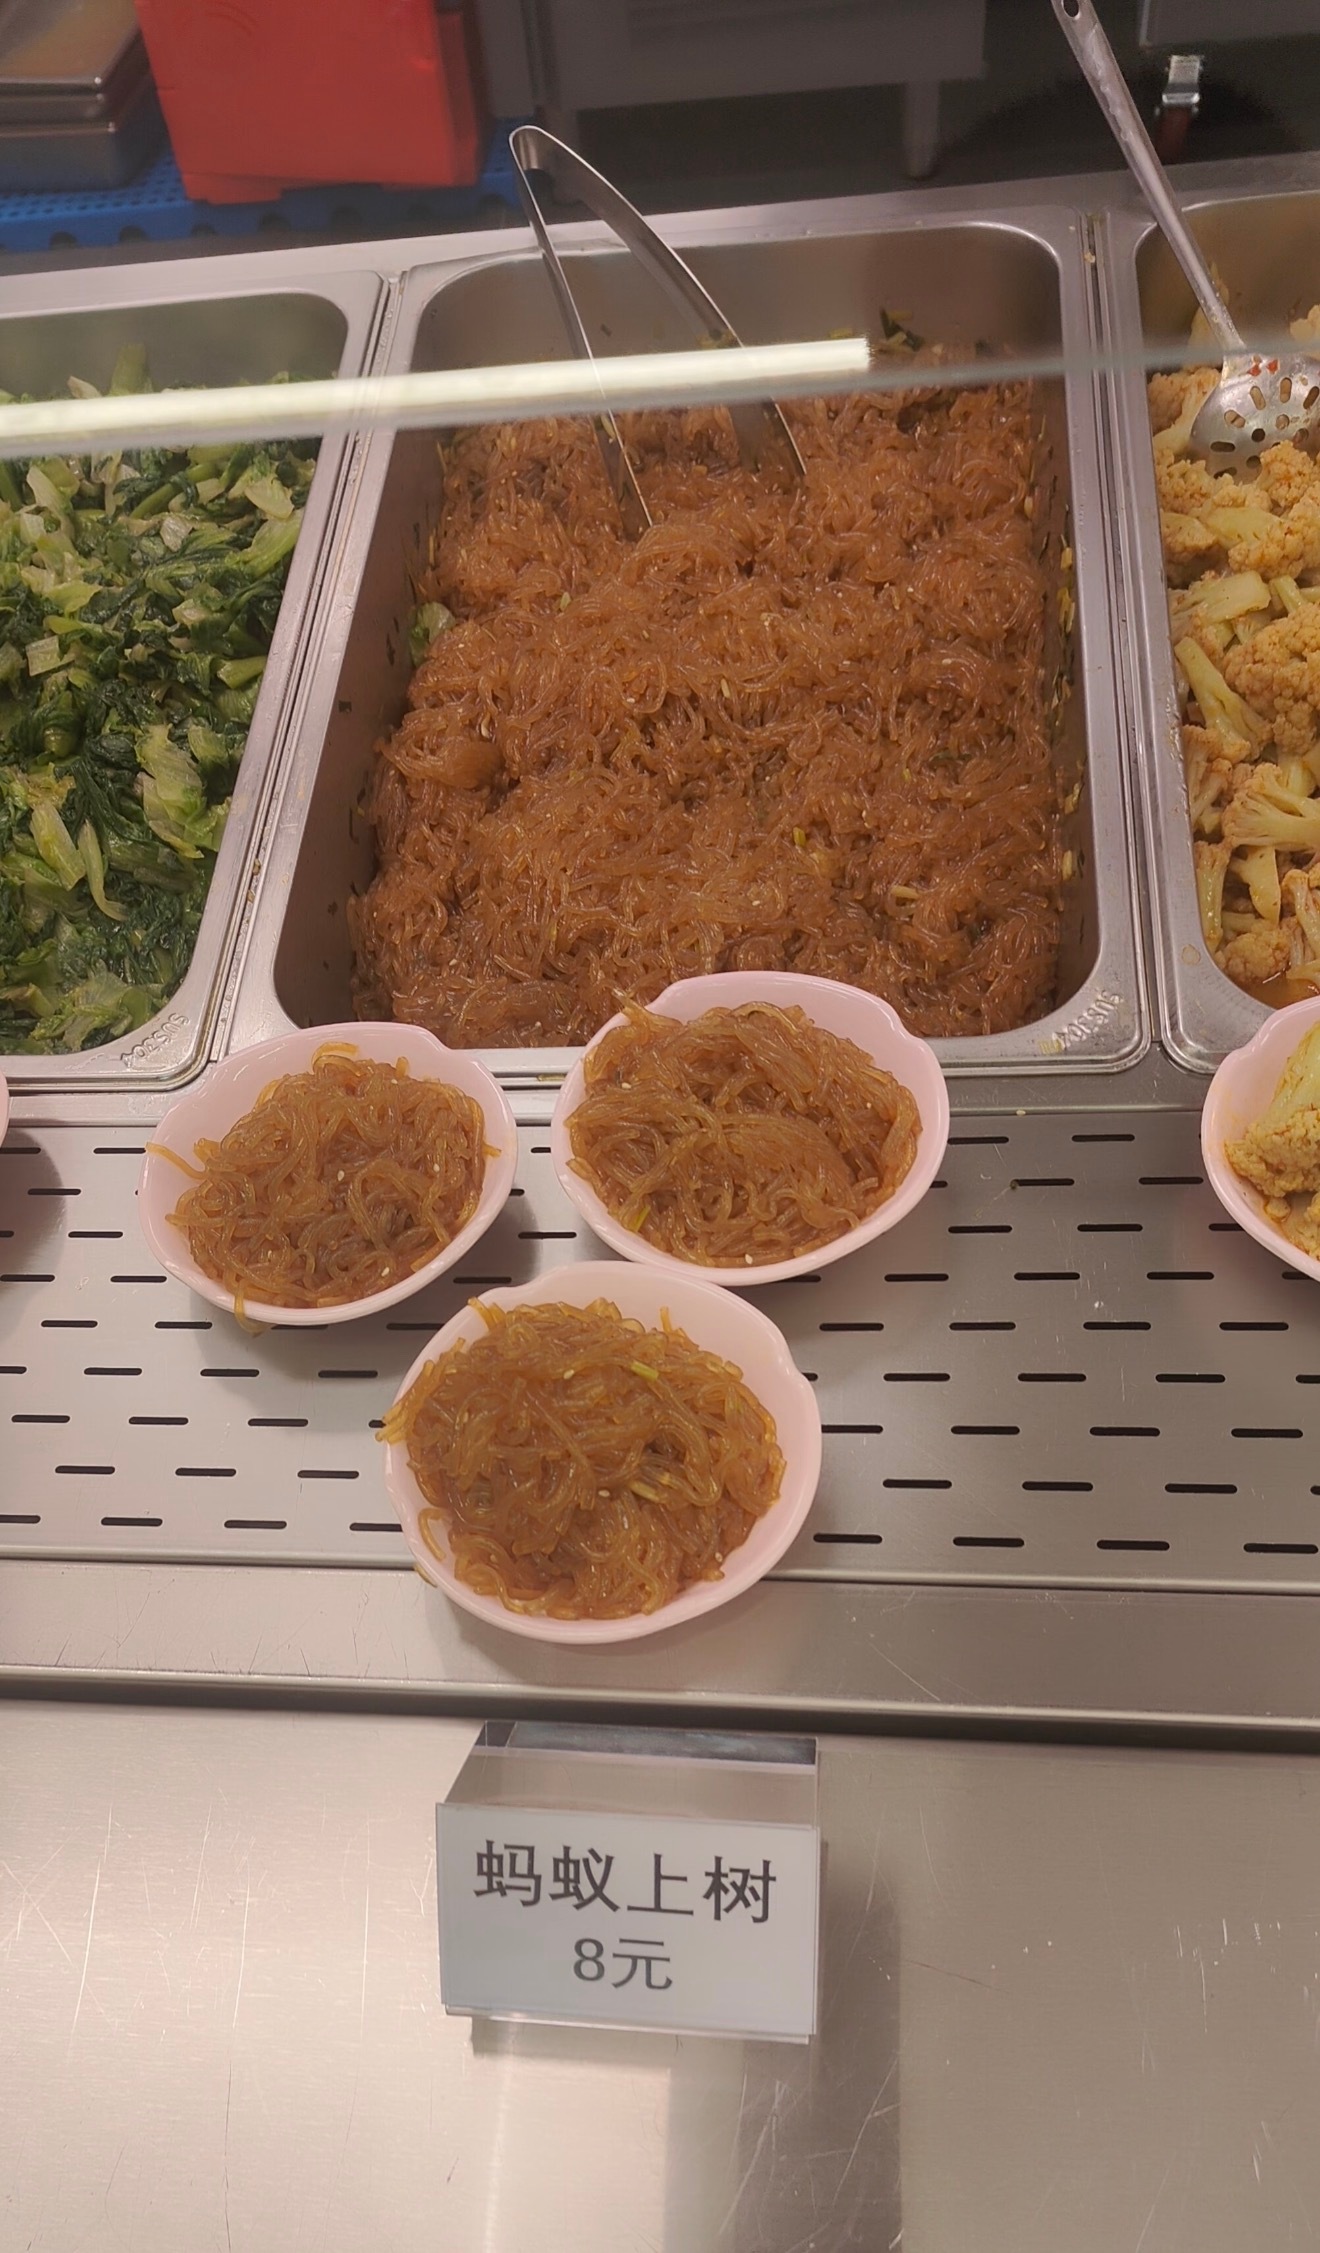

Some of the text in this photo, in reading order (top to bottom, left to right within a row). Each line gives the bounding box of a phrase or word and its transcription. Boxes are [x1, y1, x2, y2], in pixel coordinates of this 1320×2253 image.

[120, 1012, 190, 1068] SUS304
[1052, 989, 1123, 1051] SUS304
[473, 1839, 777, 1924] 蚂蚁上树
[573, 1937, 673, 1990] 8元
